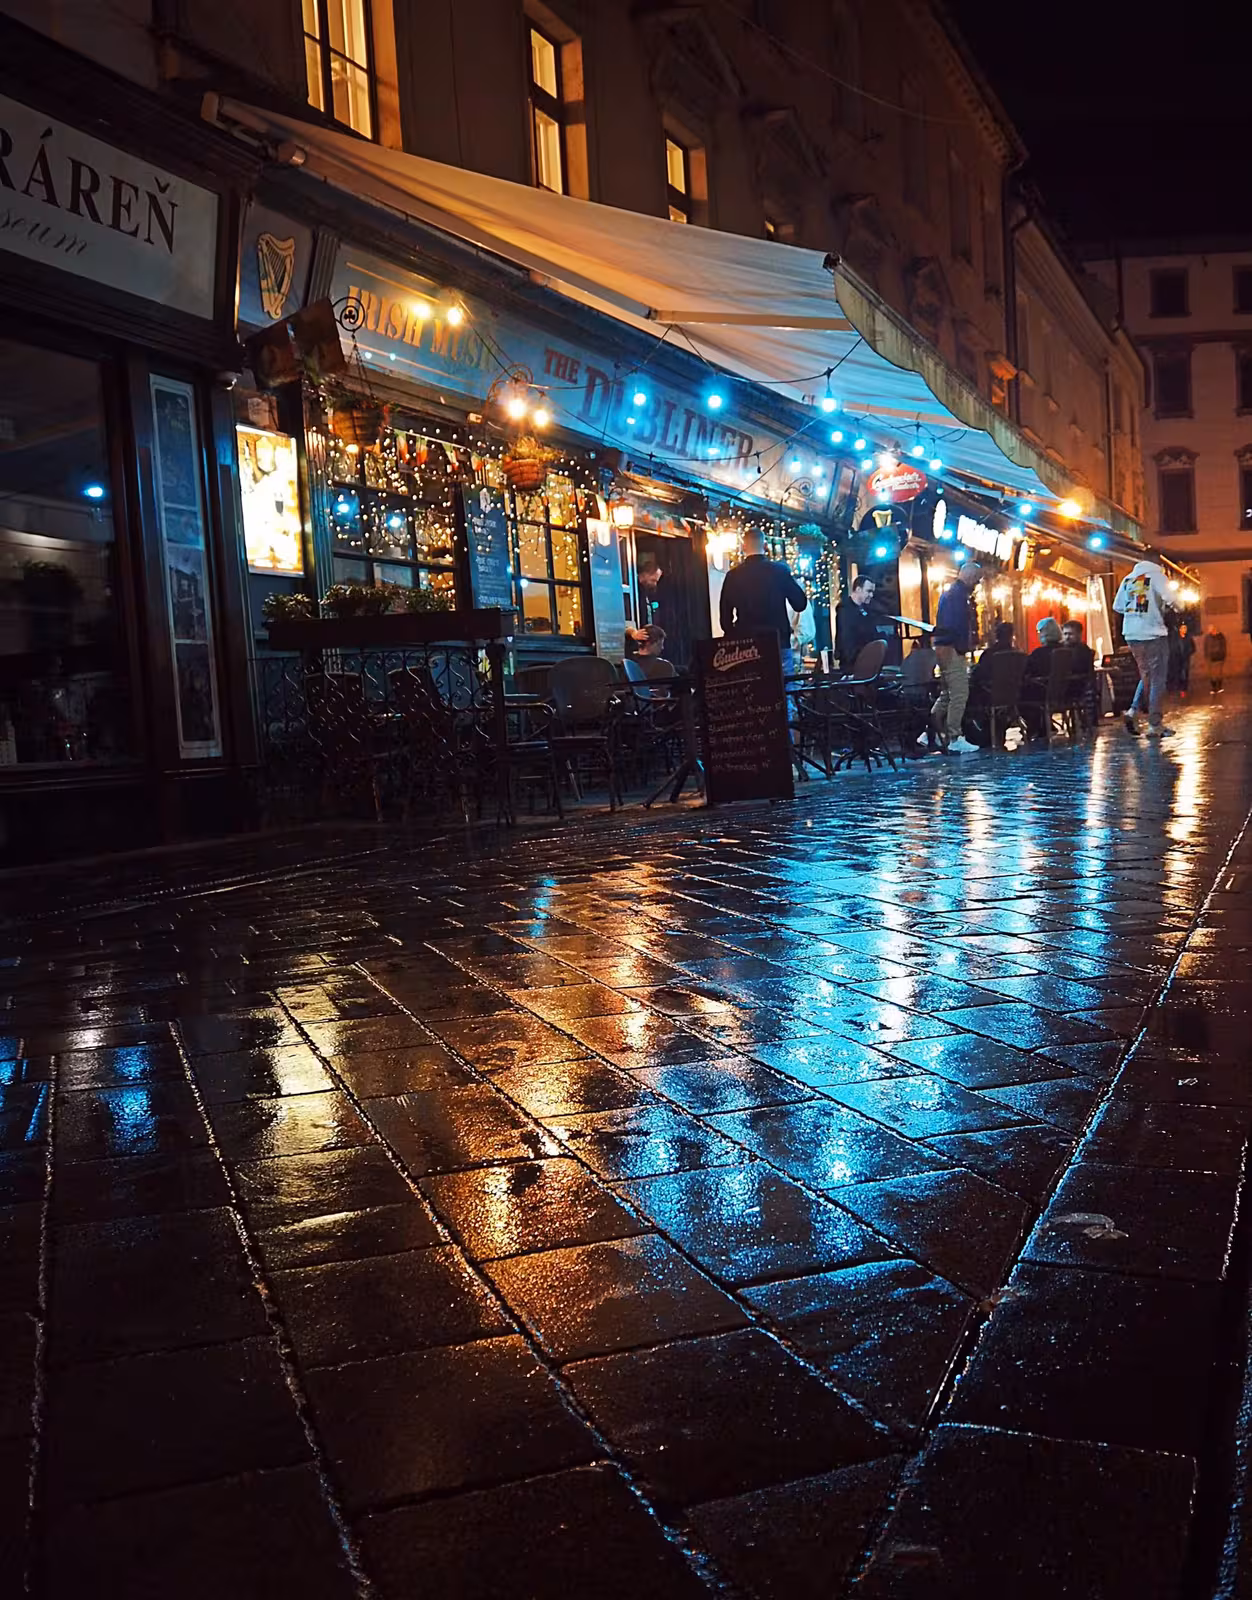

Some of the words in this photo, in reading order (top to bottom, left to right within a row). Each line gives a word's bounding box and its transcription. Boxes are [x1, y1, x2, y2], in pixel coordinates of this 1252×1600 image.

[346, 285, 426, 348] IRISH
[543, 347, 582, 384] THE
[578, 365, 754, 470] DUBLINER
